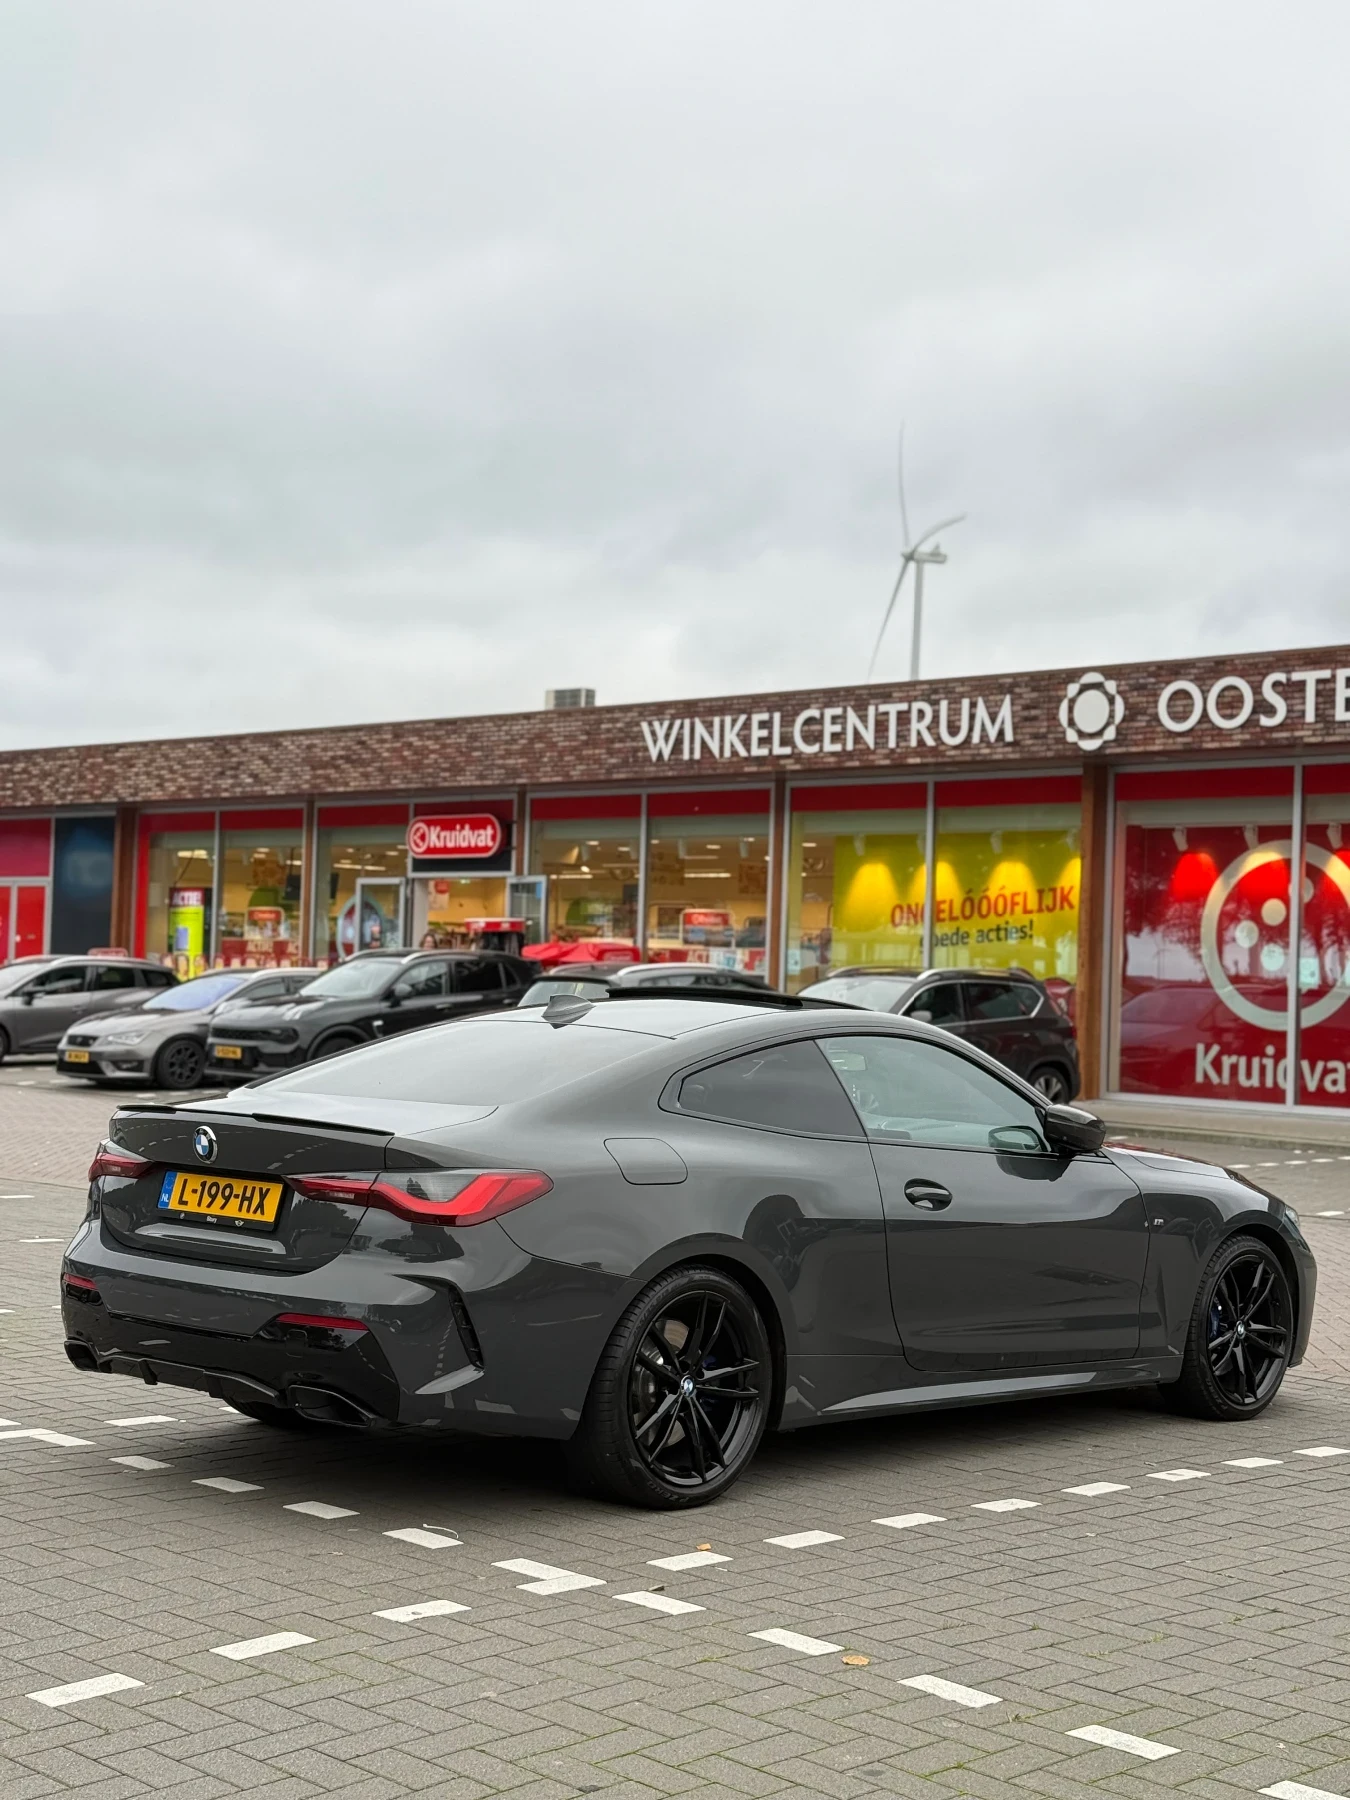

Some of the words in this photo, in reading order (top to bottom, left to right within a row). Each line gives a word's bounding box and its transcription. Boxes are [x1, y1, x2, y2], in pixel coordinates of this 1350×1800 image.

[640, 694, 1014, 763] WINKELCENTRUM
[429, 824, 494, 849] Kruidvat
[975, 919, 1034, 944] acties!
[1195, 1042, 1350, 1094] Kruiva
[178, 1178, 271, 1216] L-199-HX
